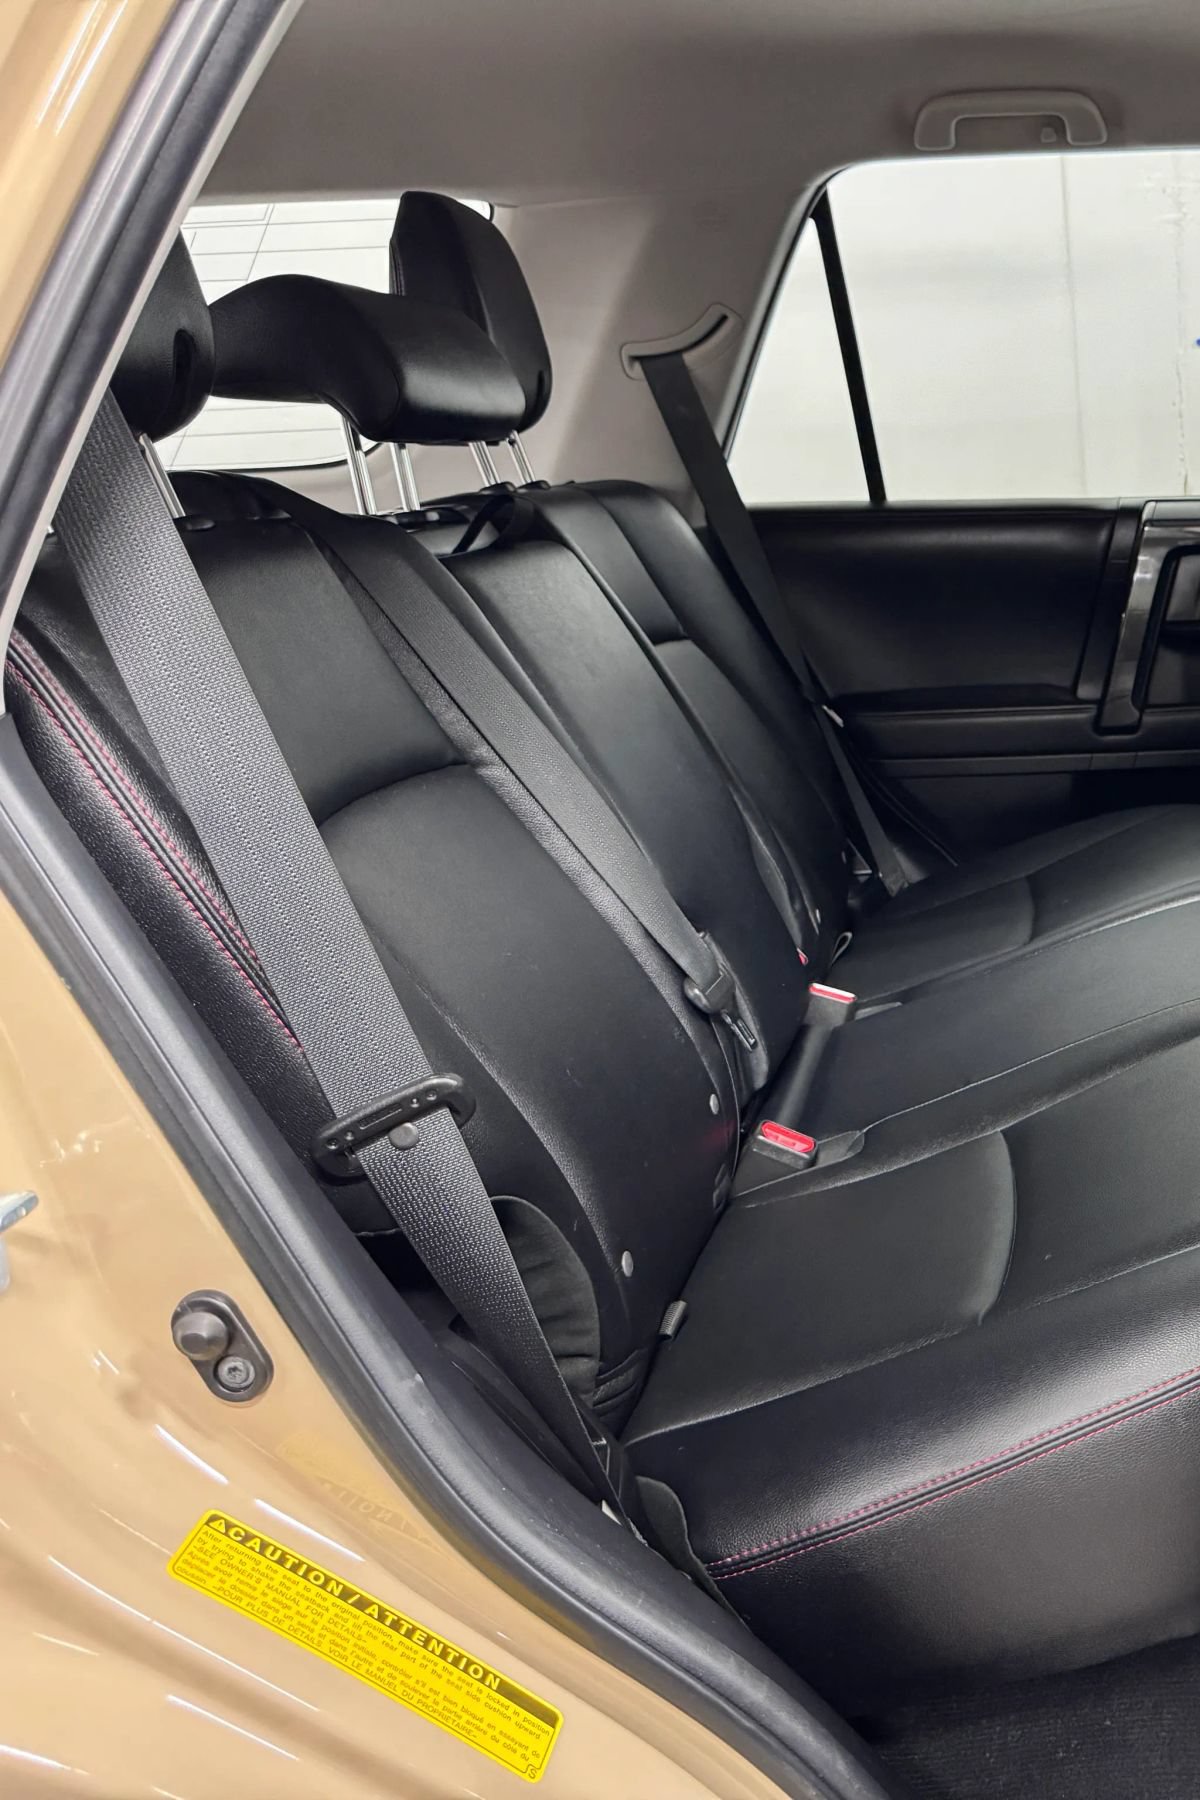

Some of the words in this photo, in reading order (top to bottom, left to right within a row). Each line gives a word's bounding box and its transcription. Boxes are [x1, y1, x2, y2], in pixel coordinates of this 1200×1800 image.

[201, 1528, 223, 1544] After
[224, 1541, 262, 1567] returning
[281, 1573, 300, 1587] seat
[329, 1600, 360, 1622] original
[361, 1618, 395, 1642] position,
[397, 1639, 419, 1656] make
[420, 1654, 438, 1668] sure
[485, 1692, 510, 1711] locked
[521, 1715, 551, 1737] position
[209, 1543, 235, 1561] trying
[250, 1564, 275, 1583] shake
[294, 1589, 331, 1613] seatback
[351, 1621, 363, 1632] lift
[380, 1639, 398, 1652] rear
[399, 1650, 417, 1664] part
[464, 1689, 482, 1703] side
[482, 1700, 513, 1722] cushion
[218, 1556, 263, 1586] OWNER'S
[264, 1581, 302, 1607] MANUAL
[225, 1523, 344, 1597] CAUTION
[346, 1590, 360, 1607] /
[363, 1600, 501, 1690] ATTENTION
[244, 1600, 270, 1618] PLUS
[326, 1646, 349, 1663] VOIR
[320, 1623, 351, 1645] position
